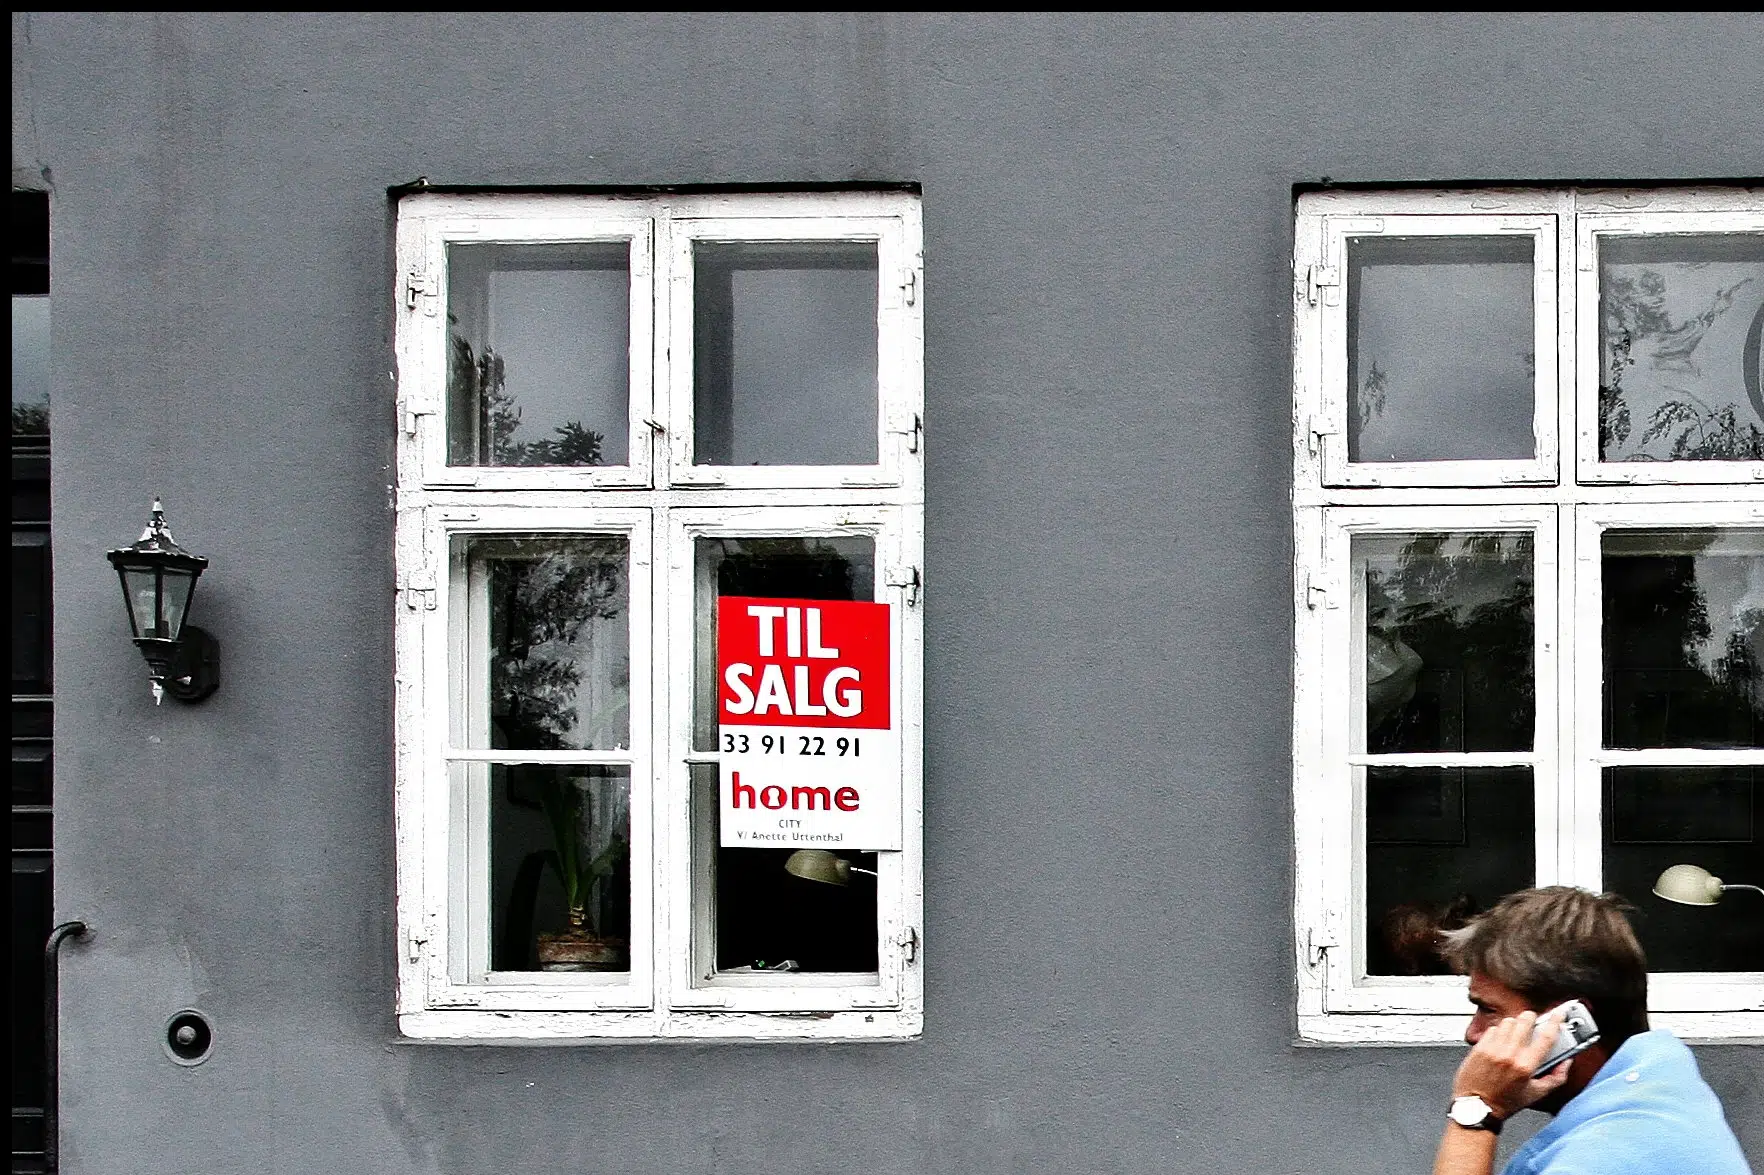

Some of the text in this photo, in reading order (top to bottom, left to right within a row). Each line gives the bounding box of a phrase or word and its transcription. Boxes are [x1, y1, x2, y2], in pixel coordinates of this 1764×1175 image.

[747, 605, 839, 659] TIL
[724, 662, 862, 718] SALG
[723, 733, 860, 757] 33 91 22 91
[732, 771, 860, 812] home
[778, 819, 802, 829] CITY
